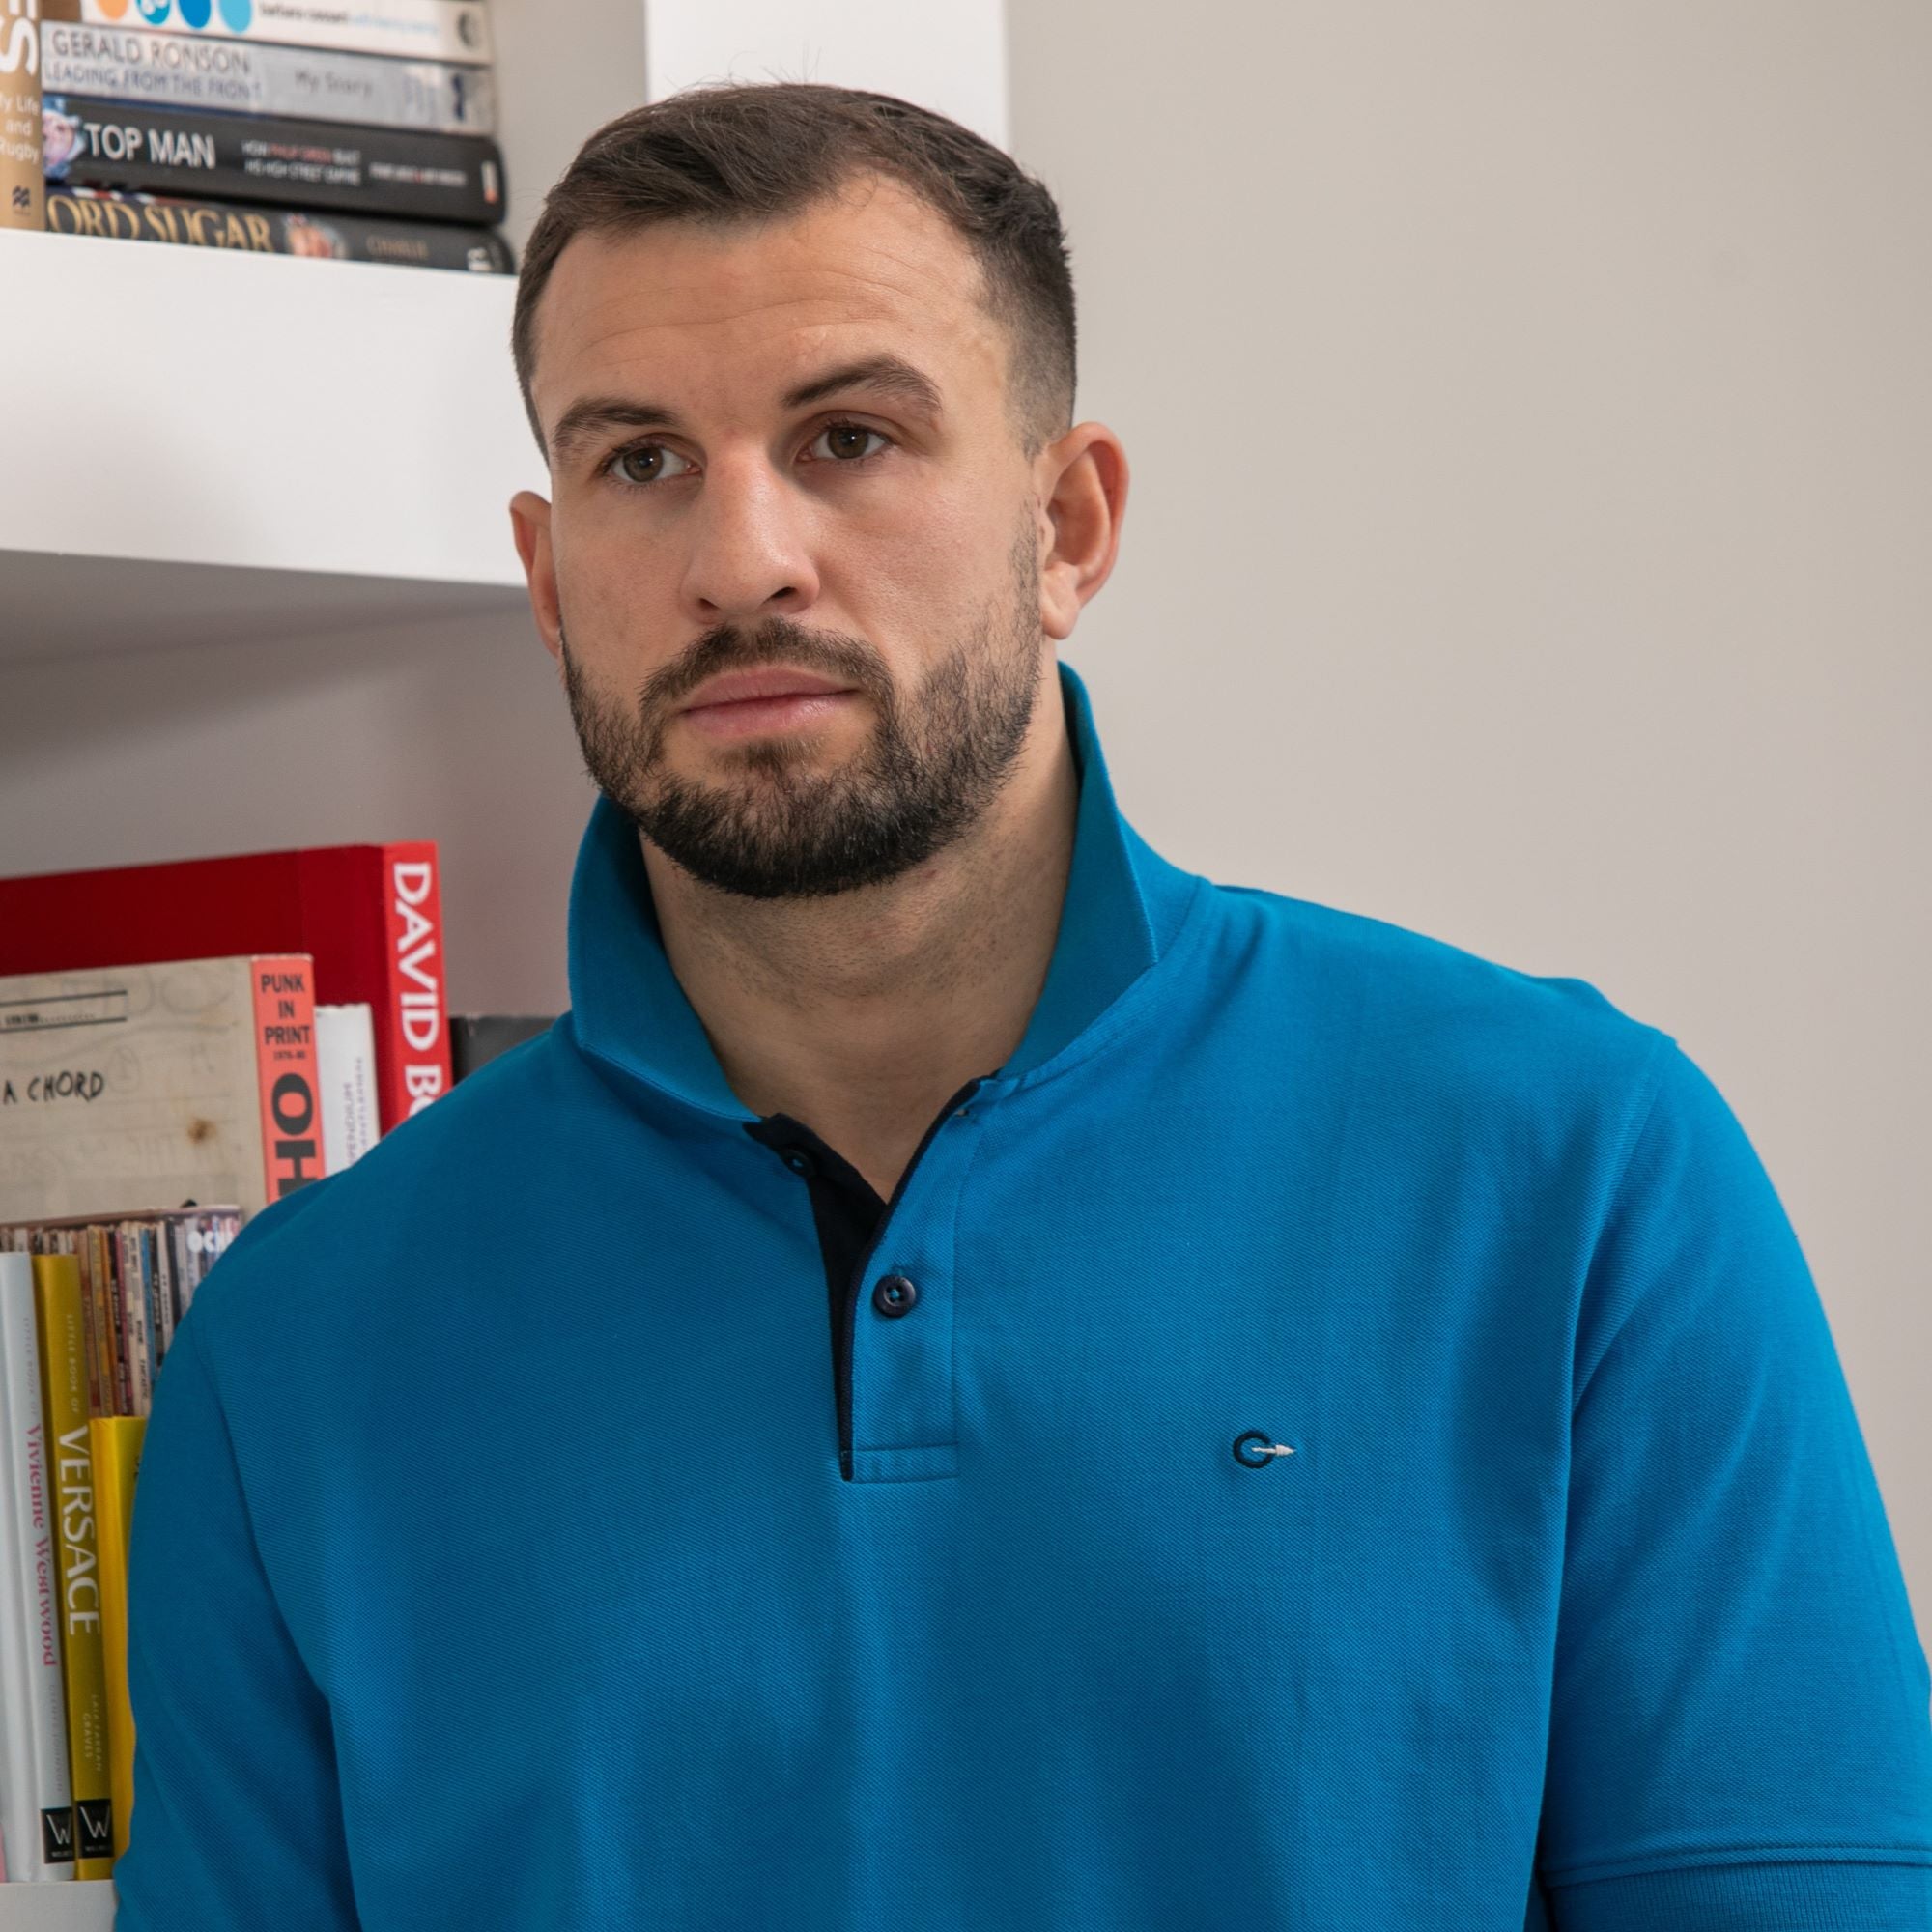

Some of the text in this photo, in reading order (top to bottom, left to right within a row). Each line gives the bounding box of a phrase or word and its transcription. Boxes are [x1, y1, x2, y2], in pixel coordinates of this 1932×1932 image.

[52, 29, 250, 74] GERALD RONSON
[45, 61, 262, 100] LEADING FROM THE FRONT
[295, 68, 374, 99] My Story
[6, 120, 33, 137] and
[83, 122, 216, 170] TOP MAN
[144, 205, 274, 252] SUGAR
[394, 862, 440, 1052] DAVID
[261, 974, 305, 993] PUNK
[278, 1000, 295, 1019] IN
[265, 1026, 310, 1045] PRINT
[3, 1070, 105, 1105] A CHORD
[271, 1072, 319, 1197] OH
[67, 1313, 80, 1414] LITTLE BOOK OF
[25, 1423, 58, 1667] Vivienne Westwood
[59, 1425, 99, 1636] VERSACE
